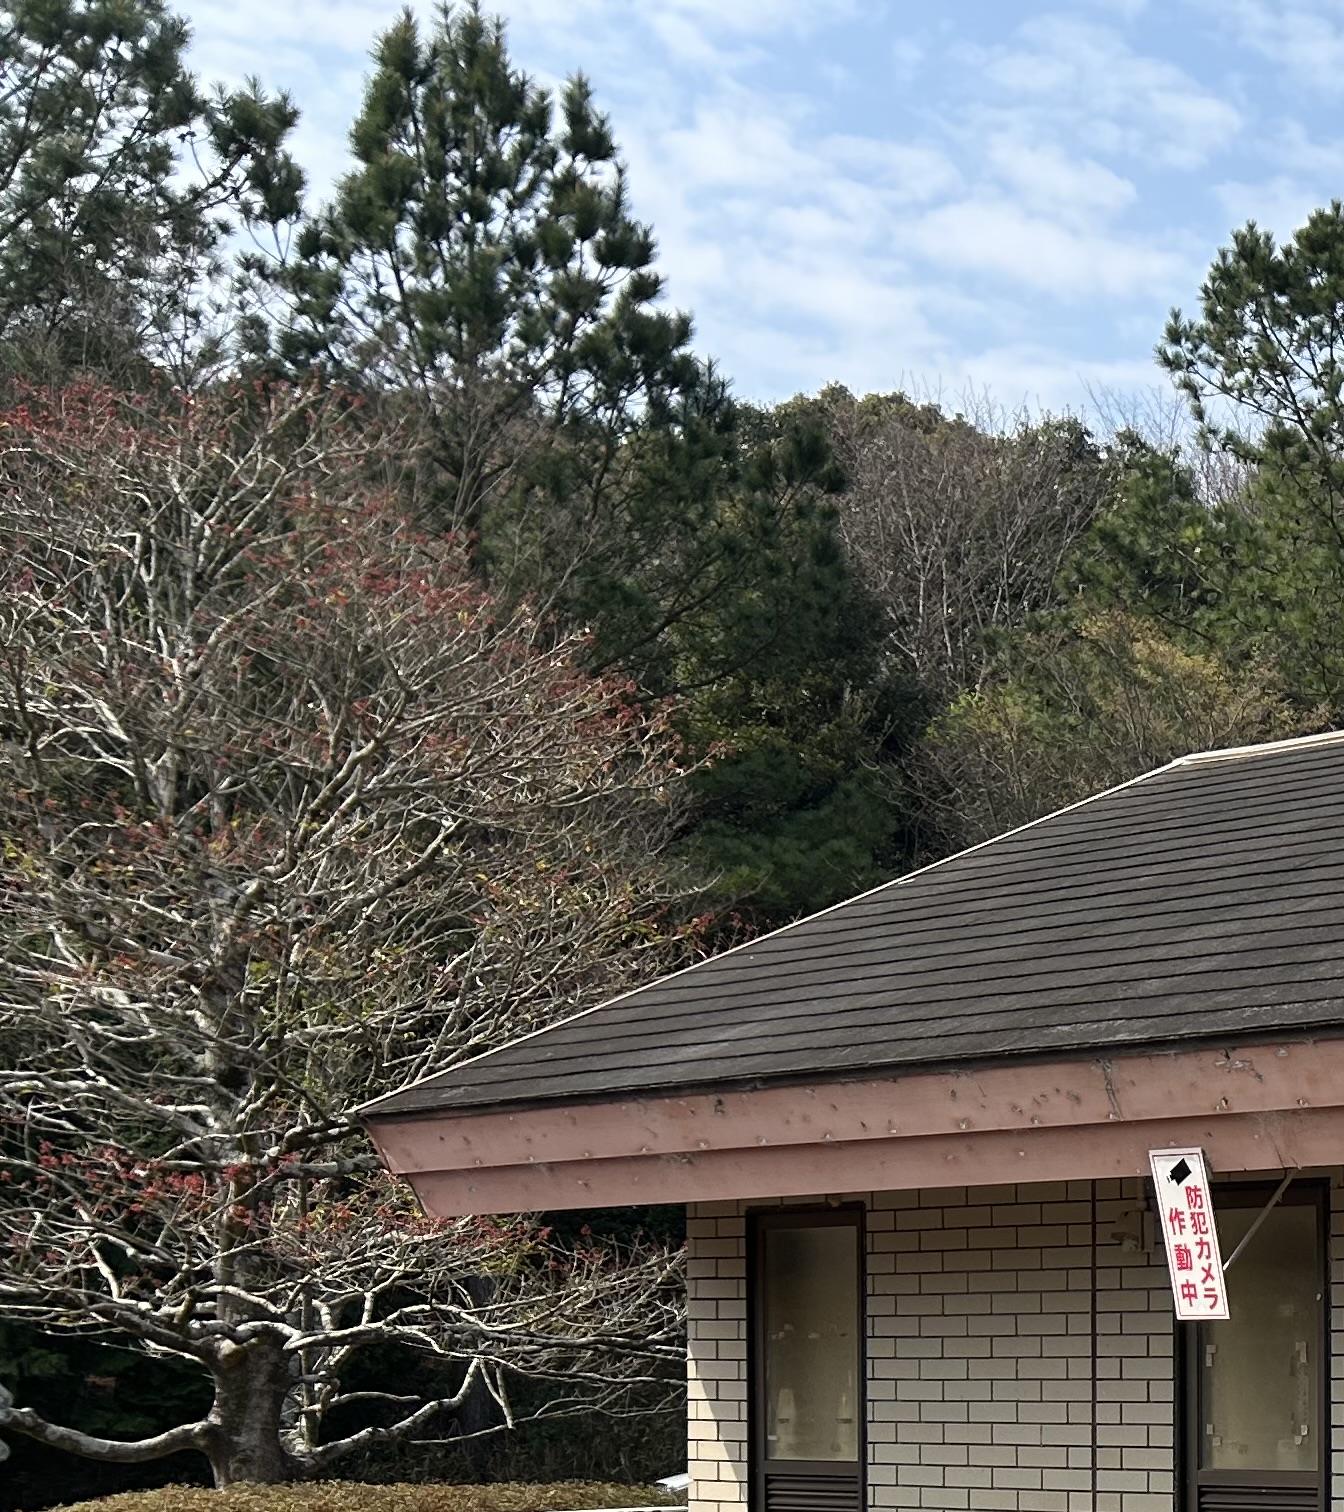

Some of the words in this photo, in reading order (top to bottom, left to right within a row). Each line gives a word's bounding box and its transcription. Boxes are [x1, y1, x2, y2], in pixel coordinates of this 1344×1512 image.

[1169, 1207, 1198, 1307] 作動中
[1185, 1185, 1219, 1309] 防犯カメラ
